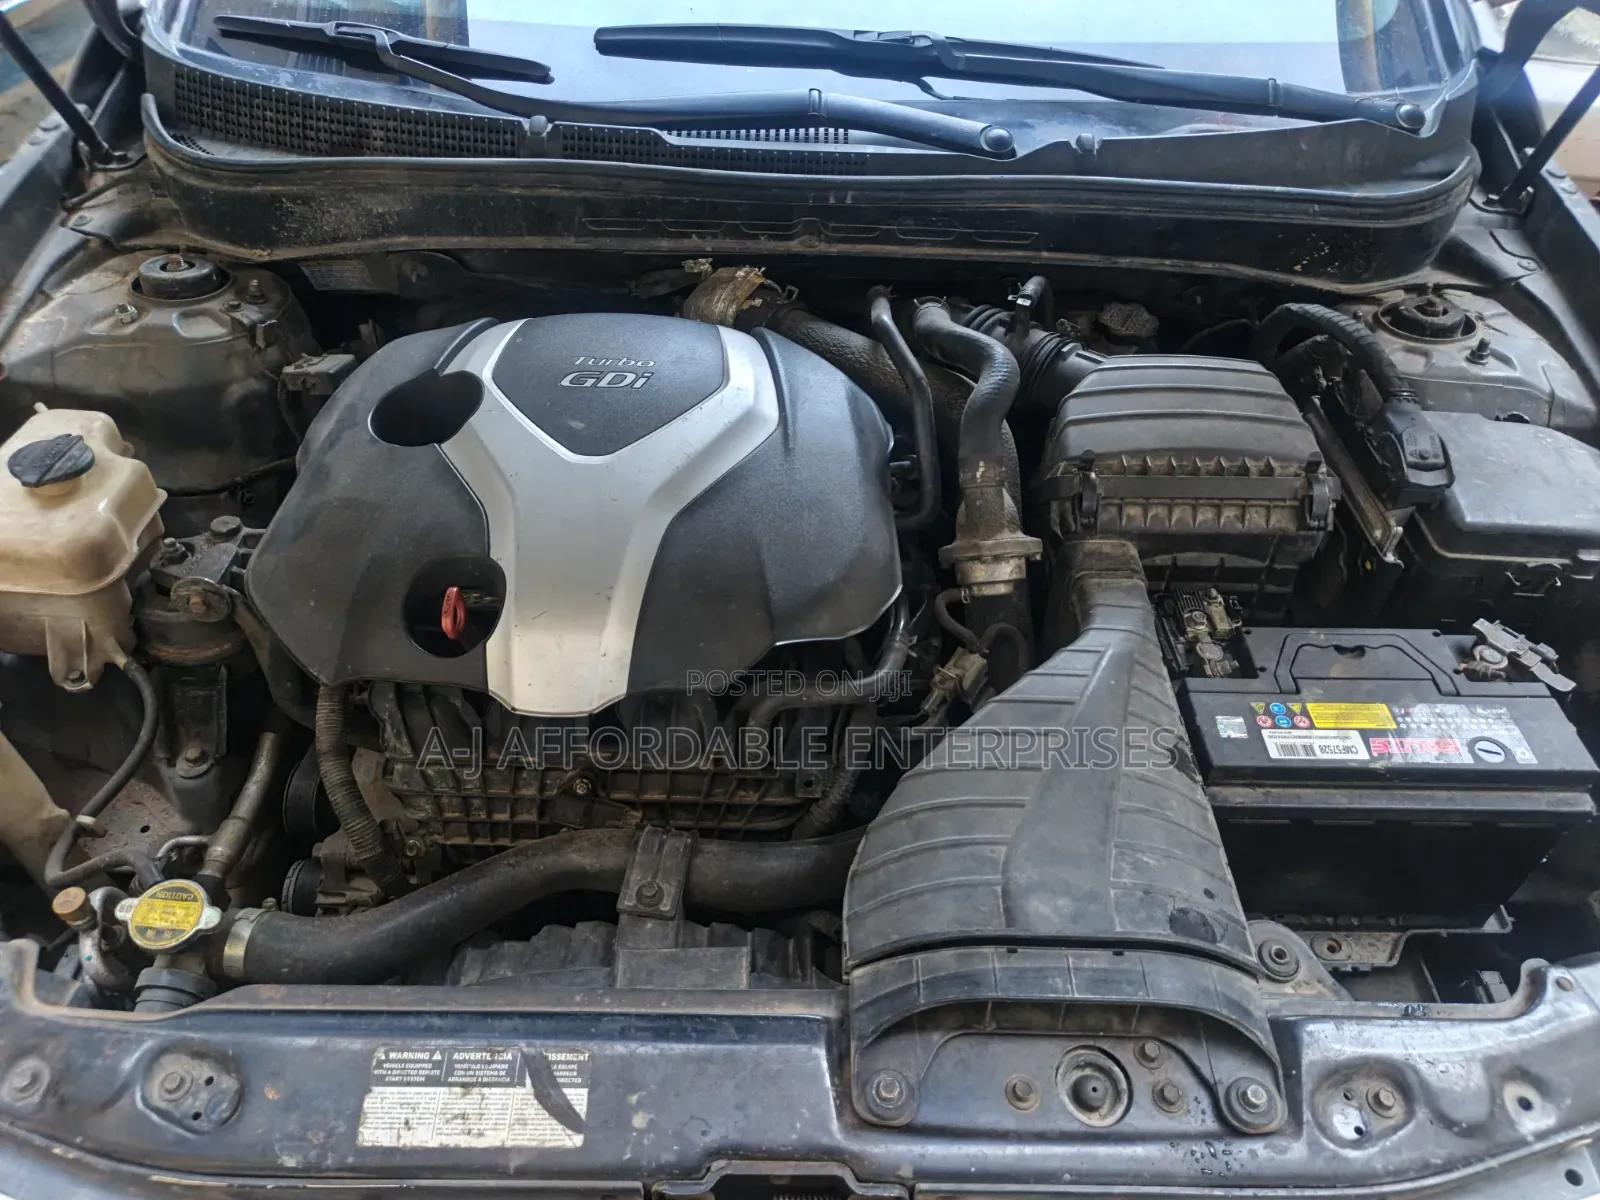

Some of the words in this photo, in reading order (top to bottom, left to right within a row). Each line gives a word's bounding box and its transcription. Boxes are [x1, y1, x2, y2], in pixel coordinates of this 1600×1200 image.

[572, 356, 656, 367] Turbo
[558, 370, 655, 389] GDi
[156, 891, 194, 900] CAUTION
[389, 1052, 430, 1060] WARNING
